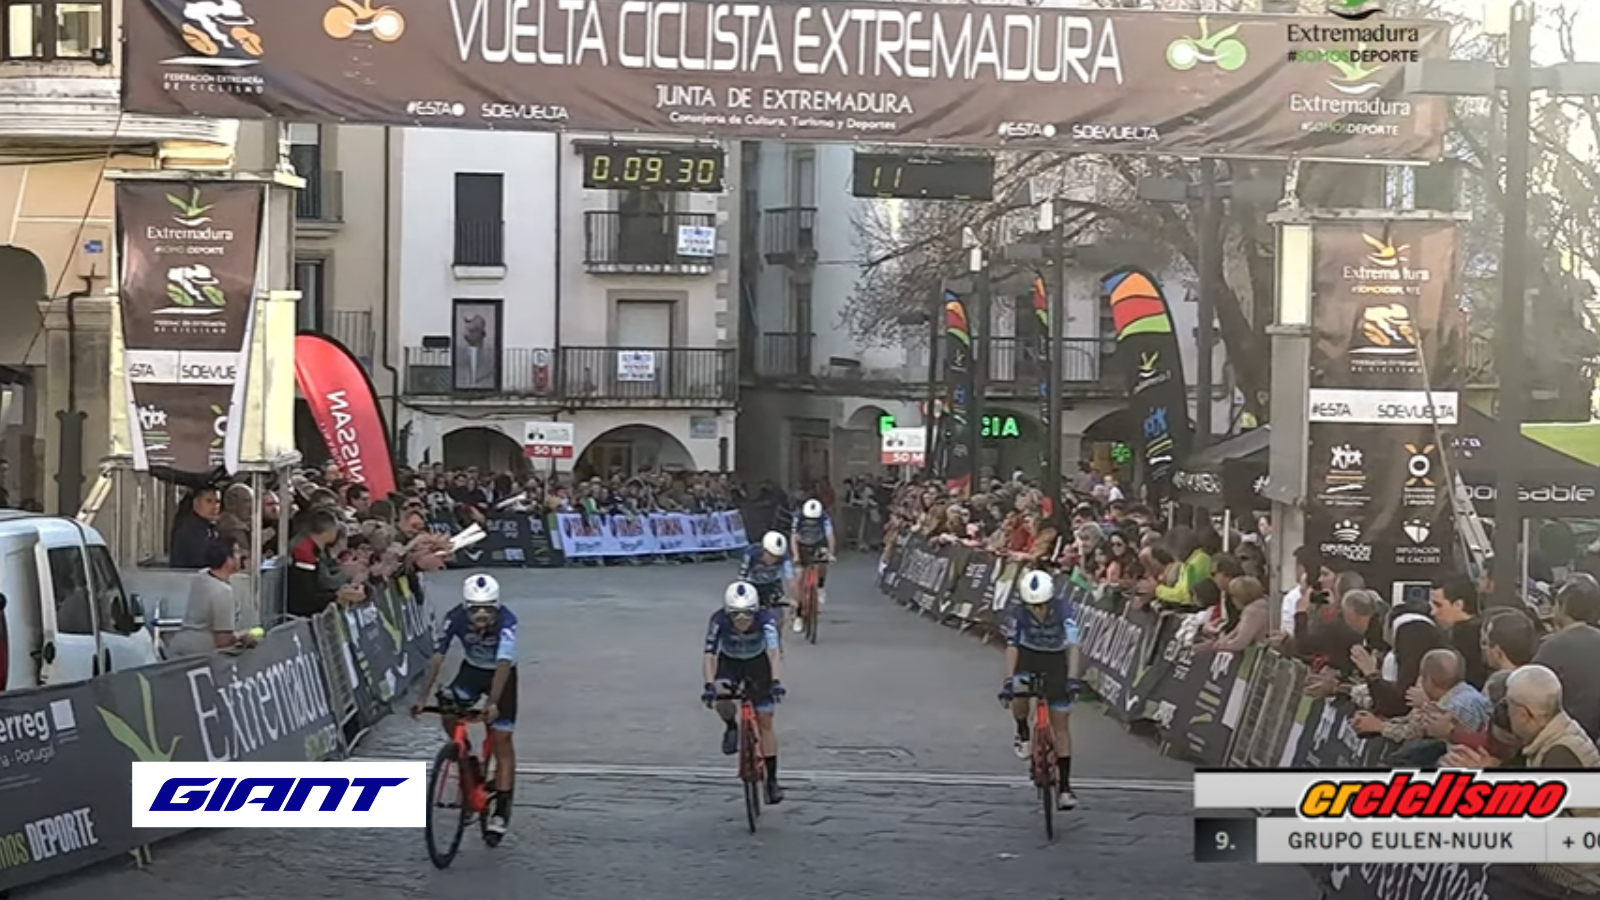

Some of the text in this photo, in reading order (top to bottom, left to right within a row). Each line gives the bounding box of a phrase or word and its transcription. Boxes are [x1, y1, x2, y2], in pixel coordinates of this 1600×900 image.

[451, 0, 1123, 85] VUELTA CICLISTA EXTREMADURA
[656, 85, 914, 113] JUNTA DE EXTREMADURA
[1289, 94, 1411, 115] Extremadura
[729, 113, 742, 125] de
[791, 116, 835, 128] Turismo
[846, 118, 896, 131] Deportes
[147, 226, 233, 240] Extremadura
[187, 632, 330, 762] Extremadu
[0, 710, 50, 742] erreg
